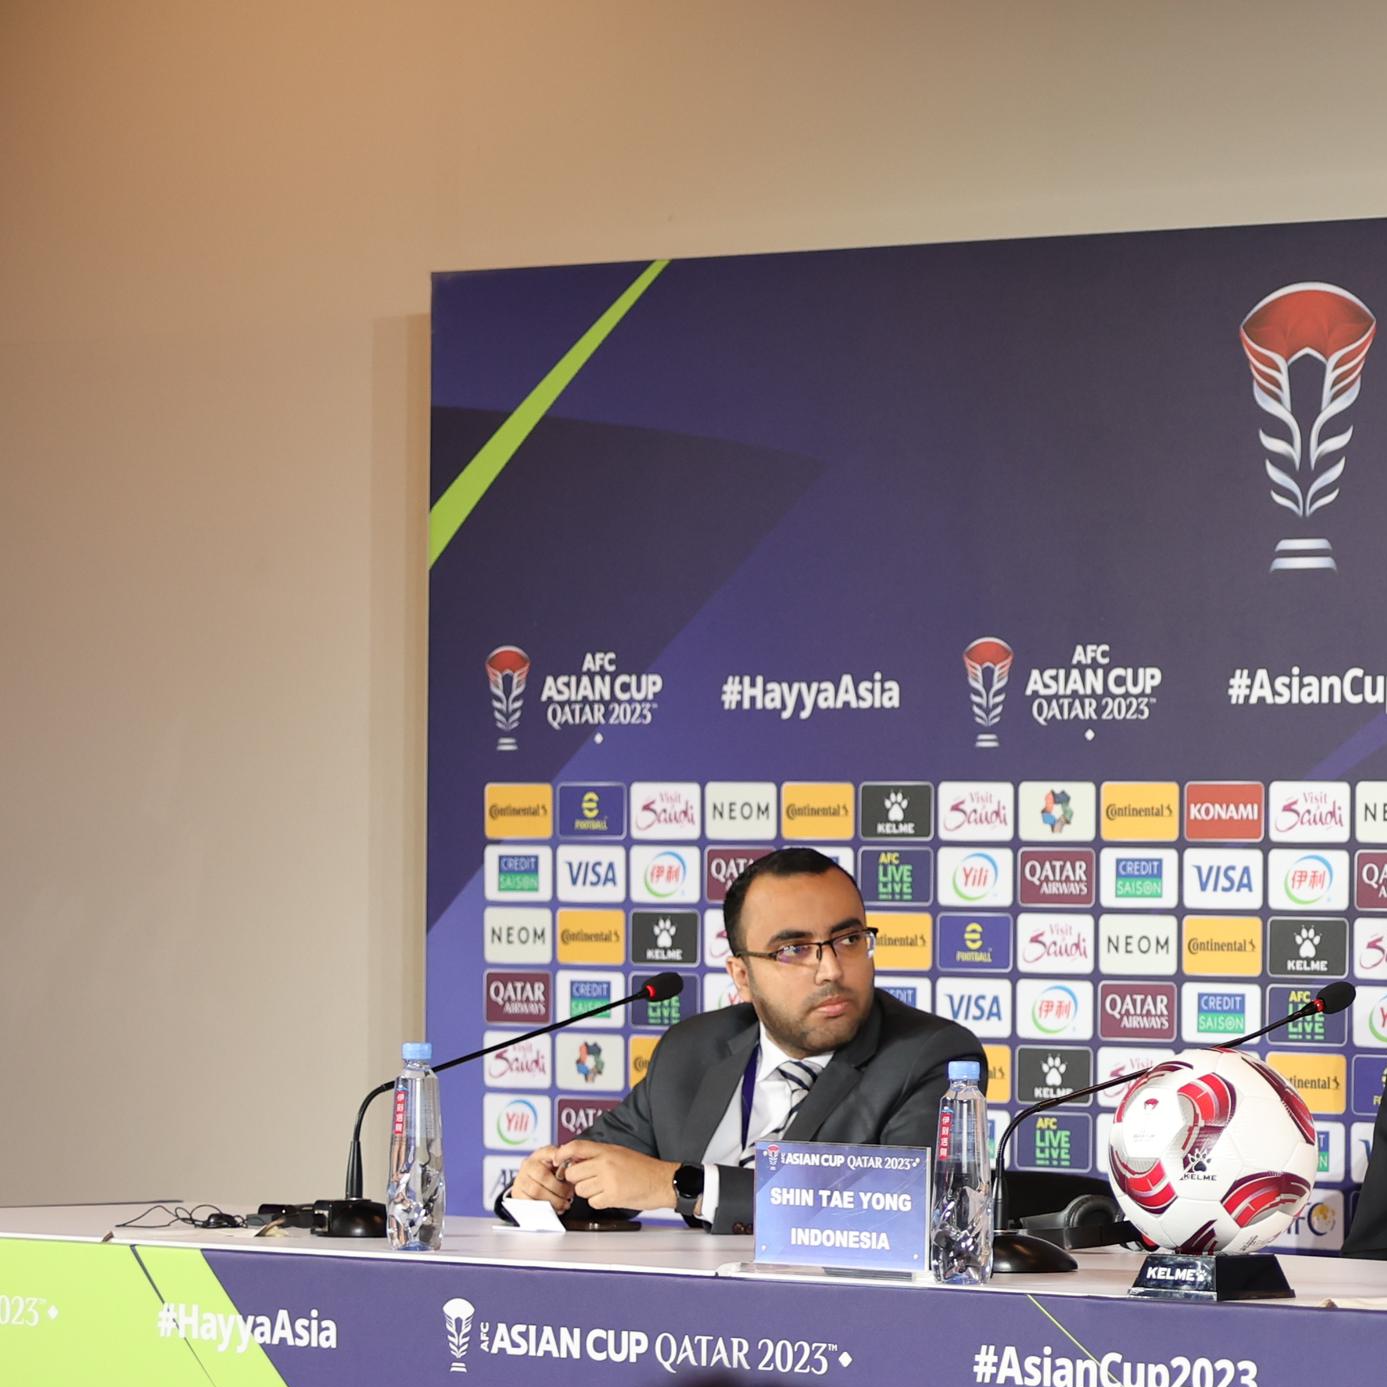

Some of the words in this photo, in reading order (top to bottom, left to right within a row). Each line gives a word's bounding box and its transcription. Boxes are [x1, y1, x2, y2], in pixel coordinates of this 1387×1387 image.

[582, 652, 616, 671] AFC
[1072, 644, 1109, 664] AFC
[541, 675, 610, 701] ASIAN
[614, 675, 662, 700] CUP
[1026, 668, 1103, 695] ASIAN
[1108, 668, 1161, 694] CUP
[722, 672, 899, 719] #HayyaAsia
[548, 704, 605, 729] QATAR
[1033, 698, 1097, 725] QATAR
[713, 802, 769, 820] NEOM
[877, 823, 914, 834] KELME
[567, 862, 616, 886] VISA
[1119, 860, 1160, 875] CREDIT
[490, 982, 545, 1006] QATAR
[504, 999, 545, 1014] AIRWAYS
[770, 1187, 814, 1207] SHIN
[819, 1190, 854, 1208] TAE
[859, 1192, 911, 1211] YONG
[791, 1228, 890, 1249] INDONESIA
[1147, 1267, 1195, 1281] KELME
[158, 1303, 337, 1352] #HayyaAsia
[480, 1322, 489, 1352] AFC
[491, 1323, 580, 1358] ASIAN
[586, 1329, 648, 1362] CUP
[655, 1333, 750, 1373] QATAR
